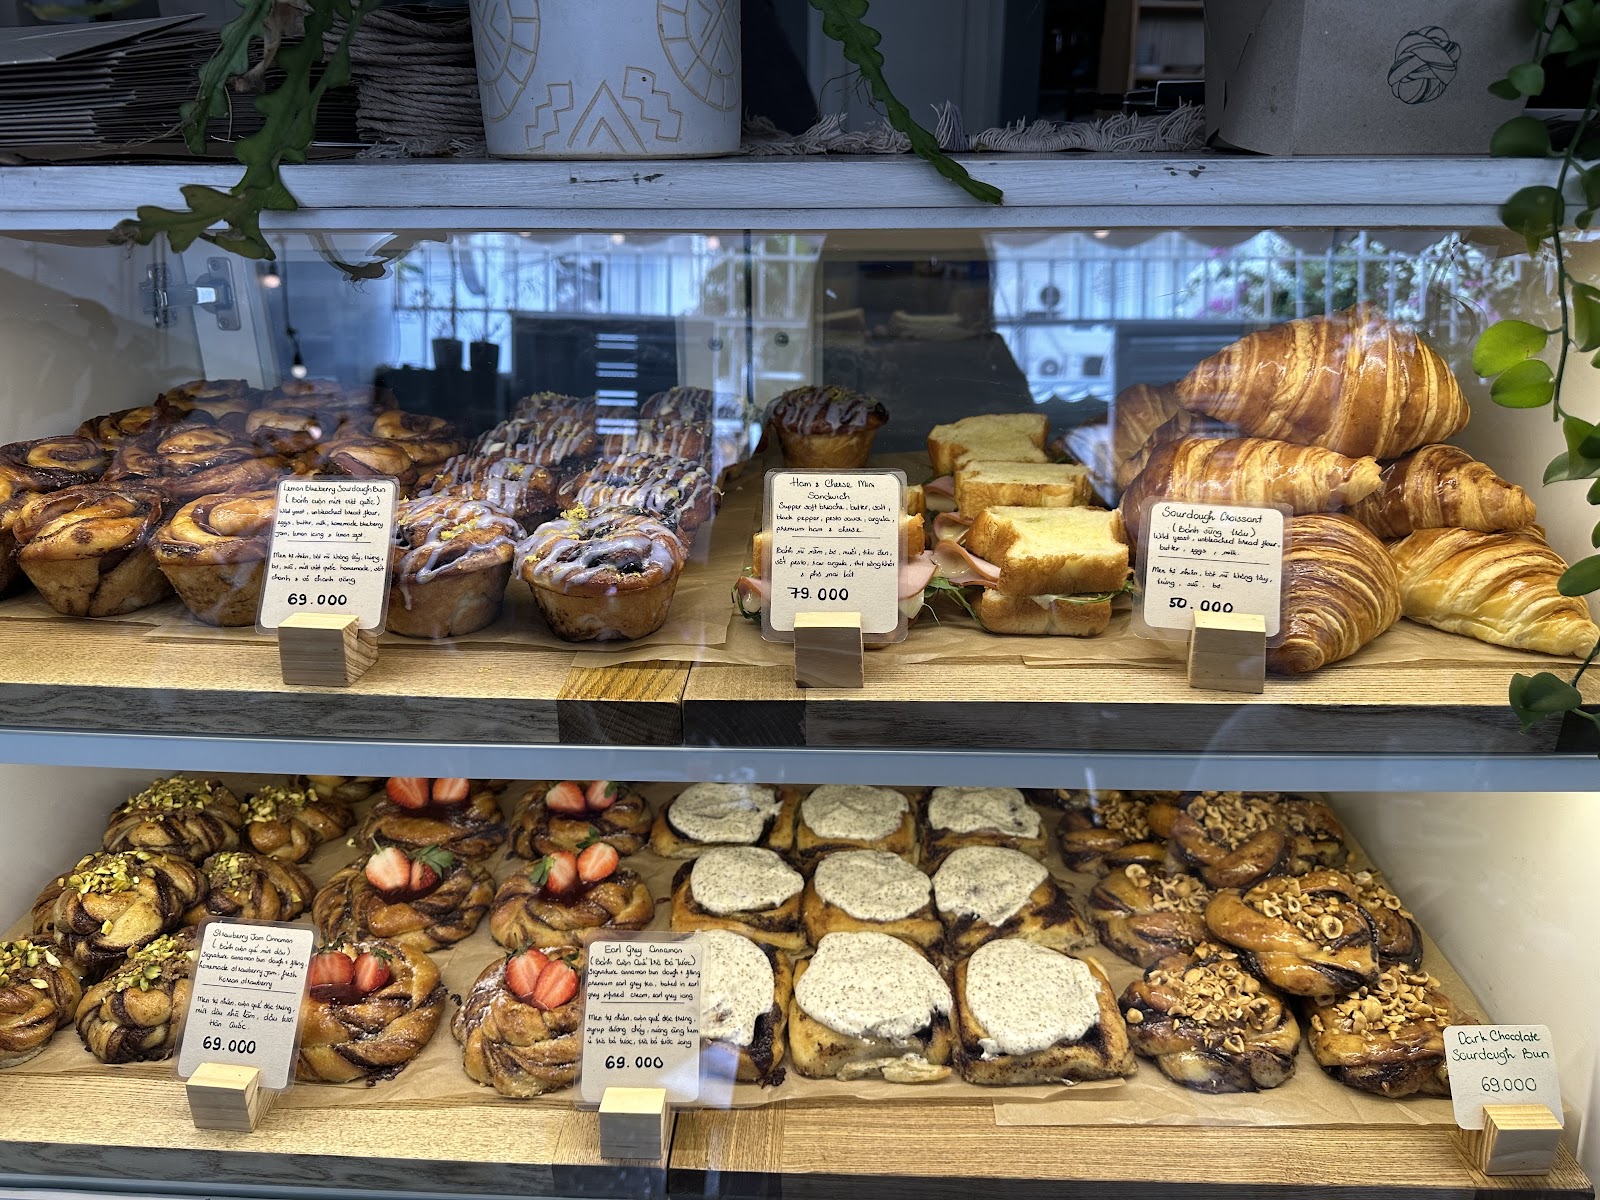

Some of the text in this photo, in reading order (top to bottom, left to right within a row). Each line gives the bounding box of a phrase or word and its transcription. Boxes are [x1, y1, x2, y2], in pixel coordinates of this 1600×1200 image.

[372, 485, 386, 493] Bun
[789, 476, 812, 488] Ham
[824, 478, 853, 488] Cheese
[807, 491, 851, 501] Sandwich
[1161, 506, 1263, 524] Sourdough Croissant
[1153, 532, 1169, 540] Wild
[1238, 538, 1259, 546] bread
[287, 592, 348, 606] 69.000
[787, 586, 849, 601] 79.000
[1169, 597, 1234, 613] 50.000
[212, 928, 249, 942] Strawberry
[250, 933, 264, 941] Jam
[604, 944, 683, 957] Earl Grey Cinnamon
[268, 957, 284, 968] dough
[661, 969, 679, 977] dough
[1457, 1029, 1541, 1045] Dark Chocolate
[202, 1035, 257, 1054] 69.000
[605, 1055, 664, 1069] 69.000
[1451, 1046, 1550, 1066] Sourdough Bun
[1481, 1076, 1537, 1093] 69.000
